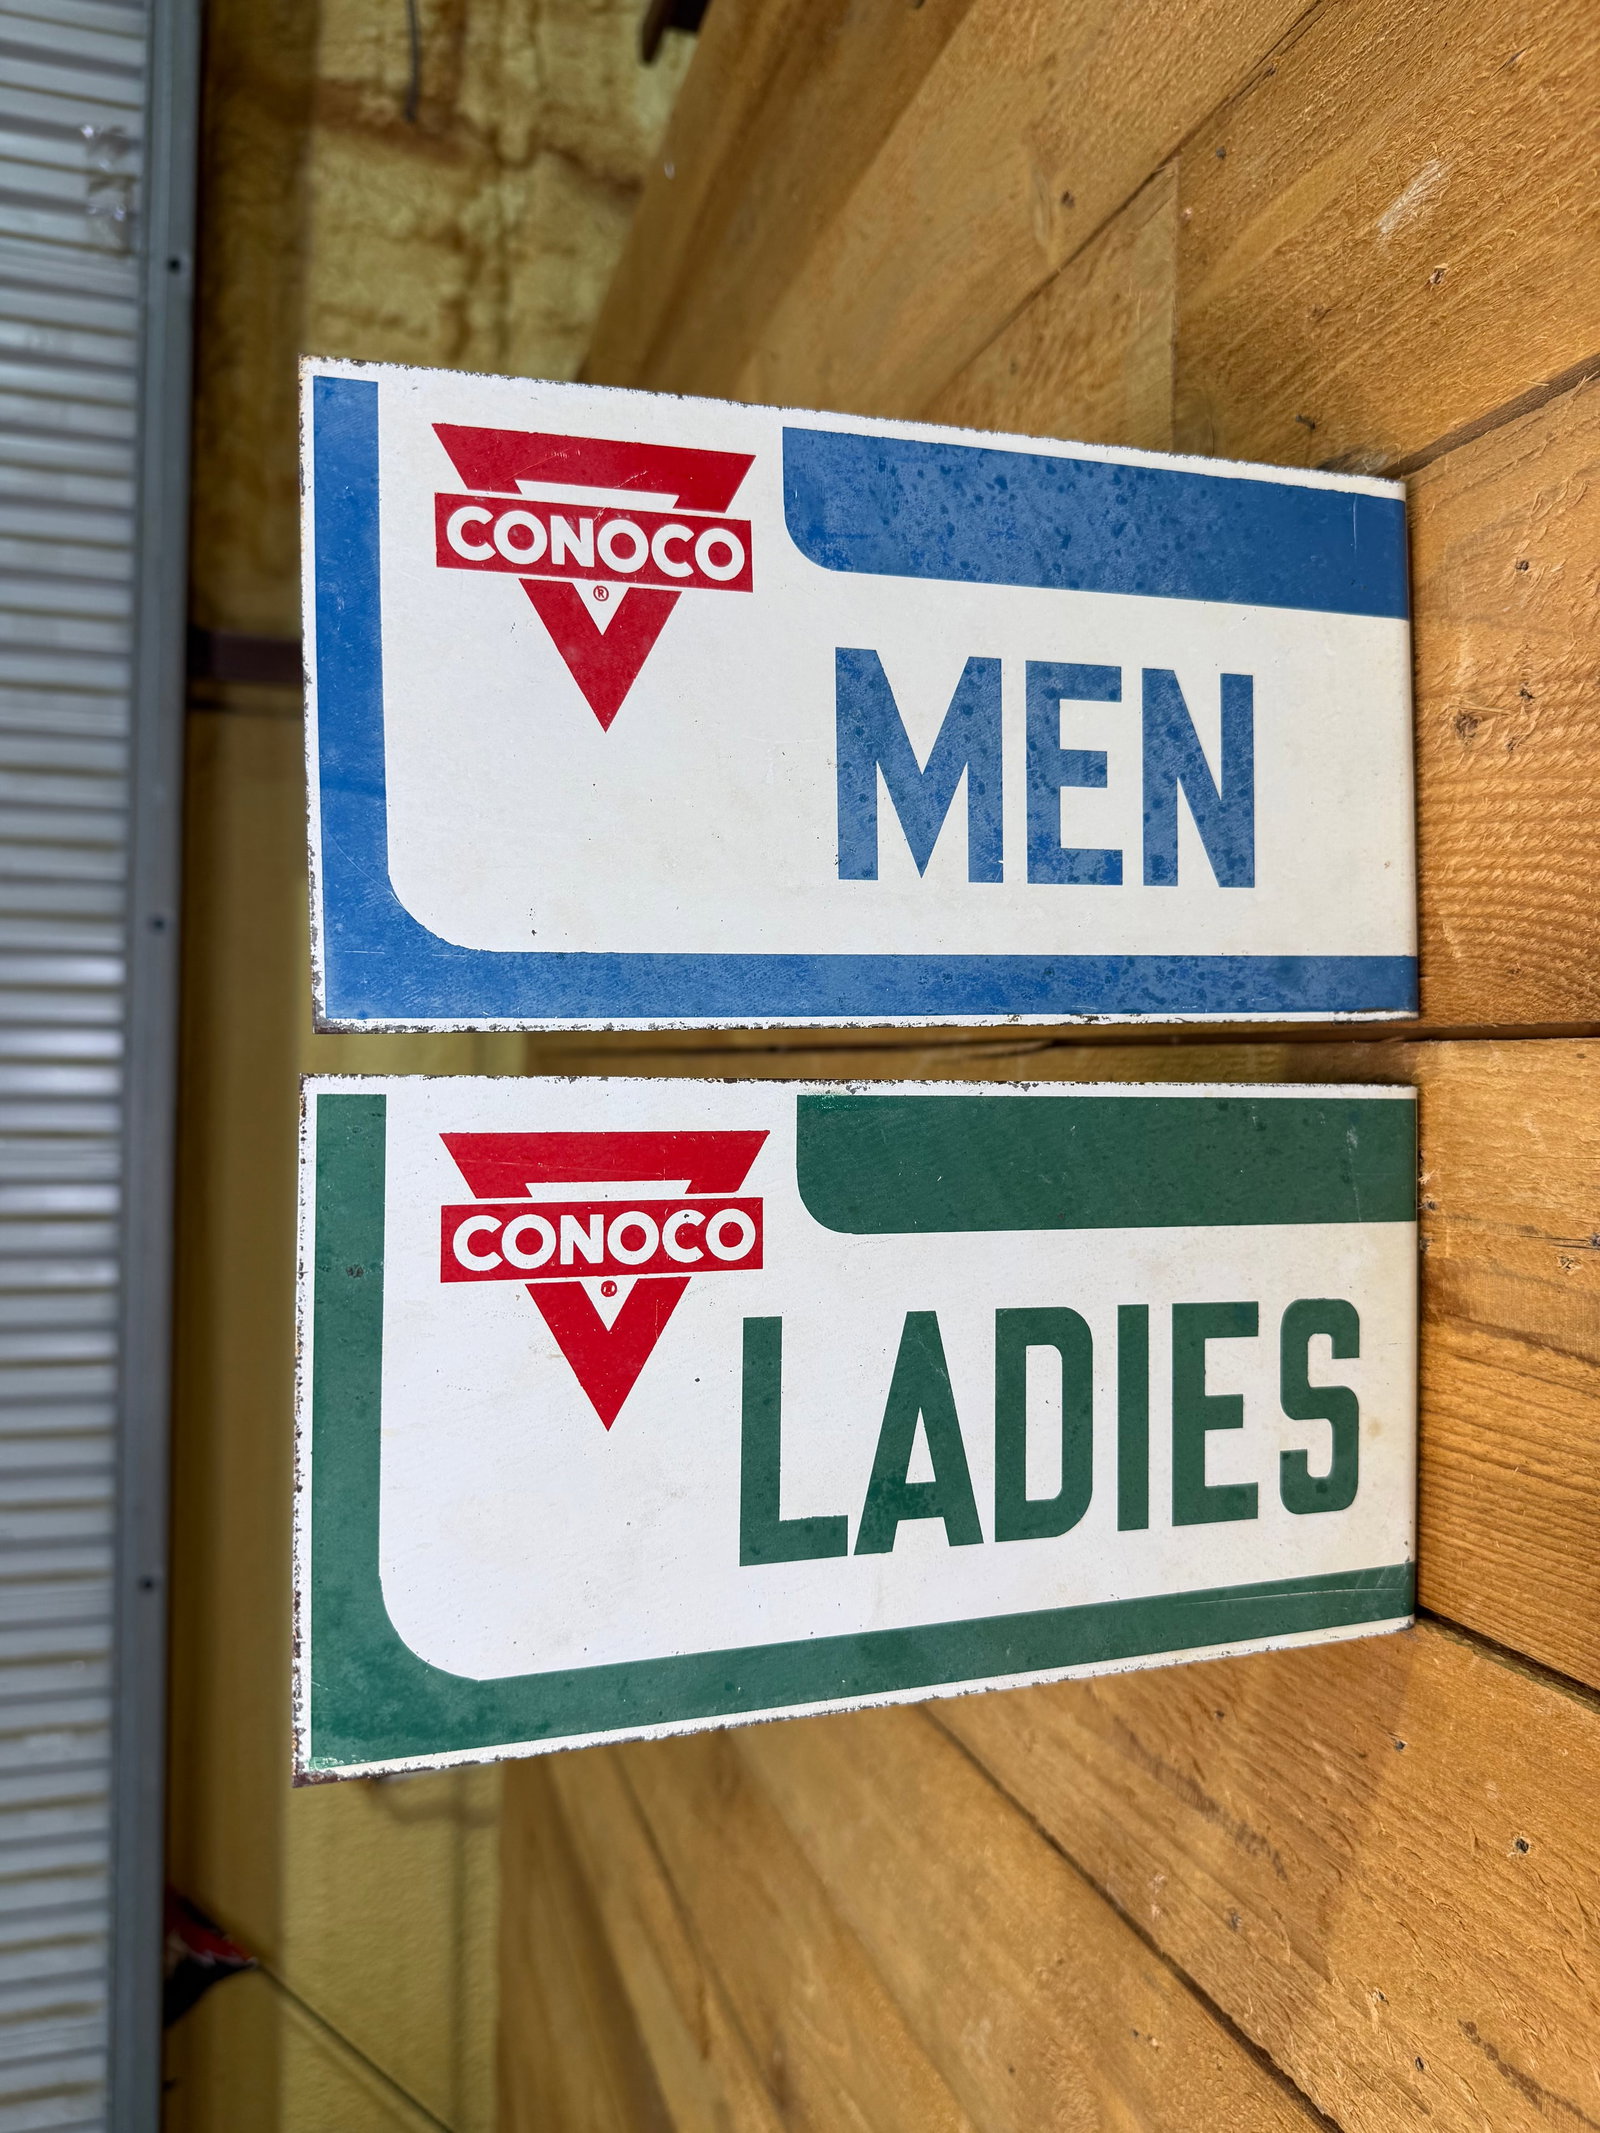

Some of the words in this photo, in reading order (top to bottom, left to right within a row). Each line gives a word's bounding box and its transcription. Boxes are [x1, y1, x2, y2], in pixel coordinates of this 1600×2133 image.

[446, 505, 746, 582] CONOCO
[834, 647, 1256, 889] MEN
[452, 1208, 757, 1272] CONOCO
[739, 1298, 1361, 1567] LADIES
